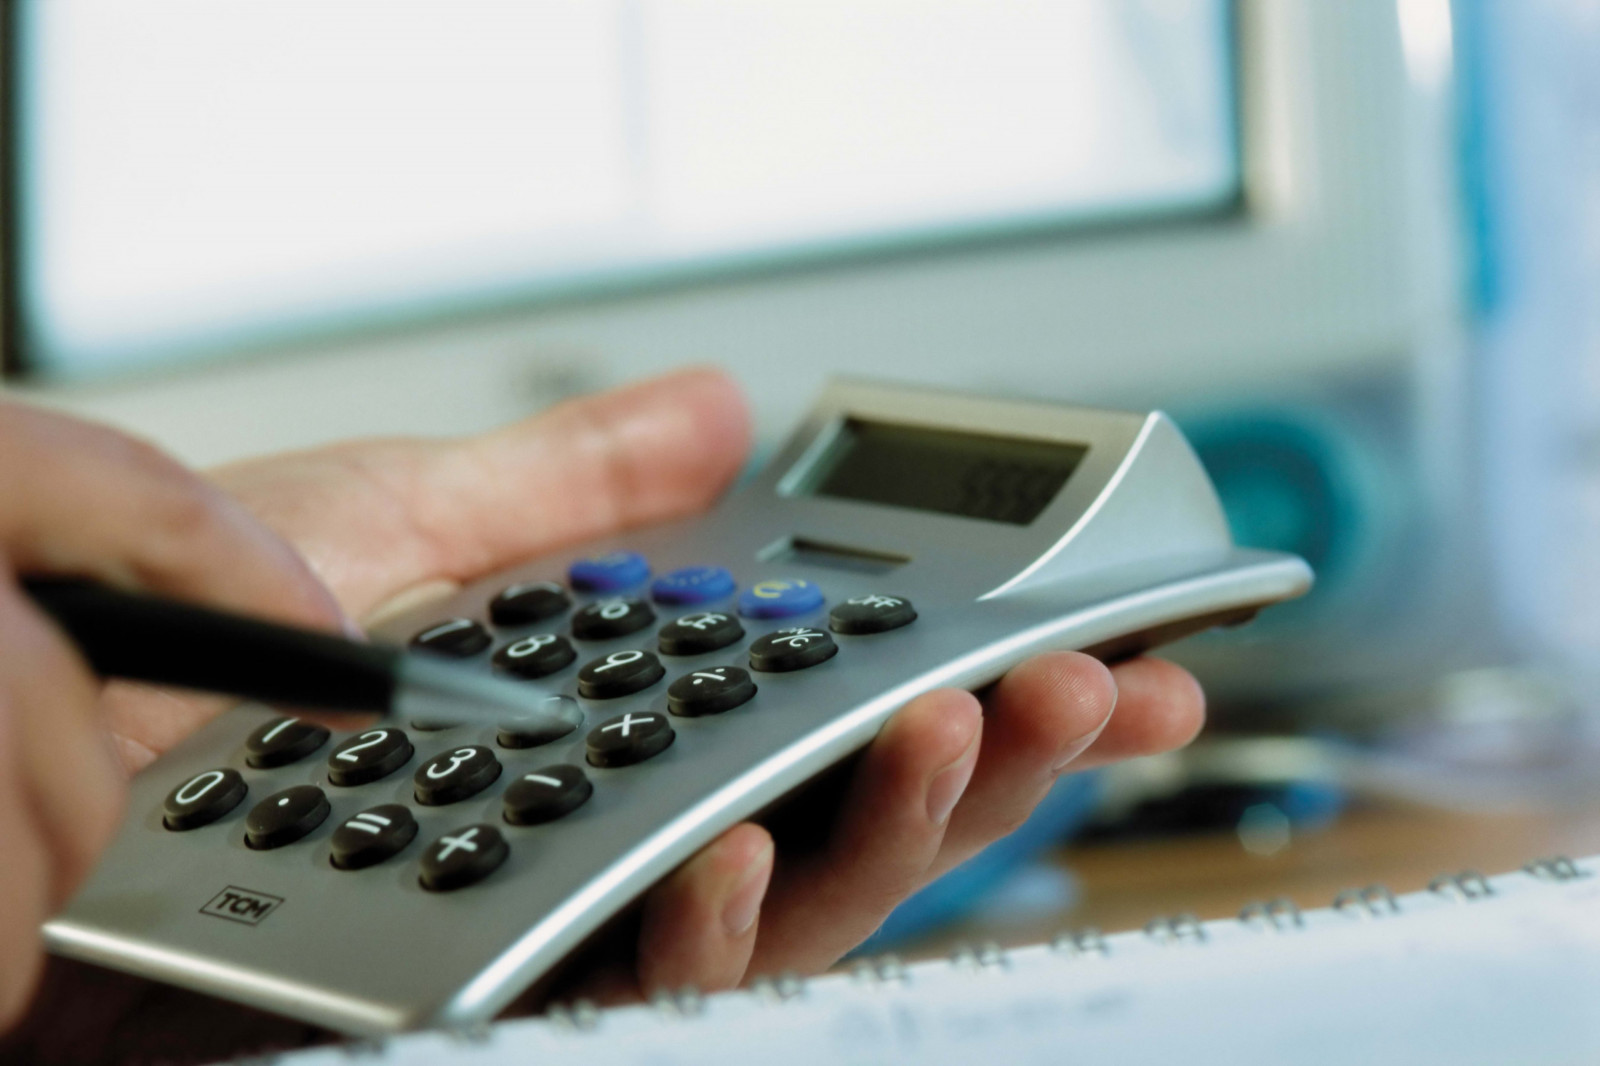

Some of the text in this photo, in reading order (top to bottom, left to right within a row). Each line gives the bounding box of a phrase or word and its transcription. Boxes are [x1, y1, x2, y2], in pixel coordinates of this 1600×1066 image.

[507, 633, 557, 659] 8
[593, 650, 644, 673] 9
[336, 729, 389, 763] 2
[426, 748, 477, 779] 3
[175, 770, 225, 805] 0
[216, 892, 273, 919] TCM
